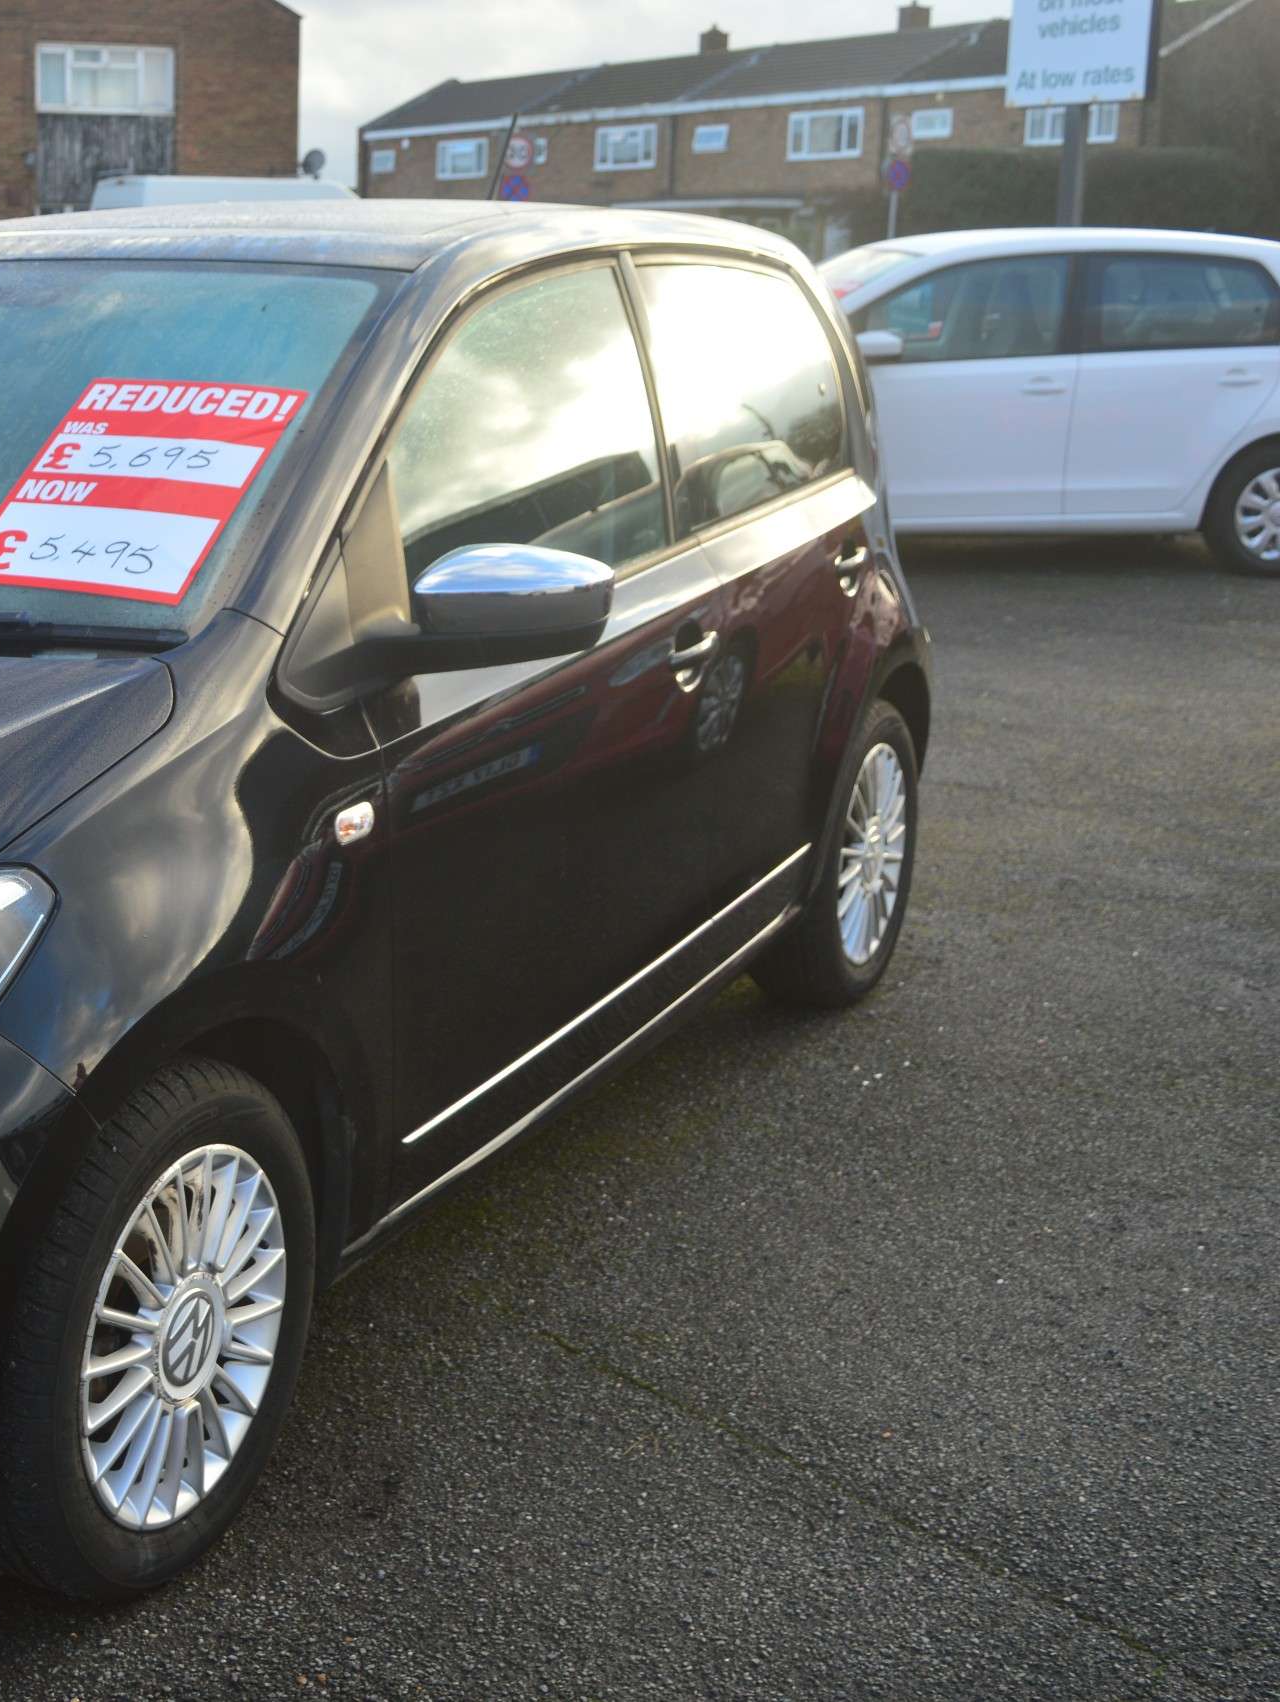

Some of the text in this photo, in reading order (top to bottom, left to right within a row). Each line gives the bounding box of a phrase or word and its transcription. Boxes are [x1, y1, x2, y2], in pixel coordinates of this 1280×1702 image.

[1038, 13, 1121, 39] vehicles
[1016, 66, 1135, 91] At low rates
[77, 383, 298, 423] REDUCED!
[63, 421, 109, 435] WAS
[42, 442, 81, 470] £
[16, 479, 97, 503] NOW
